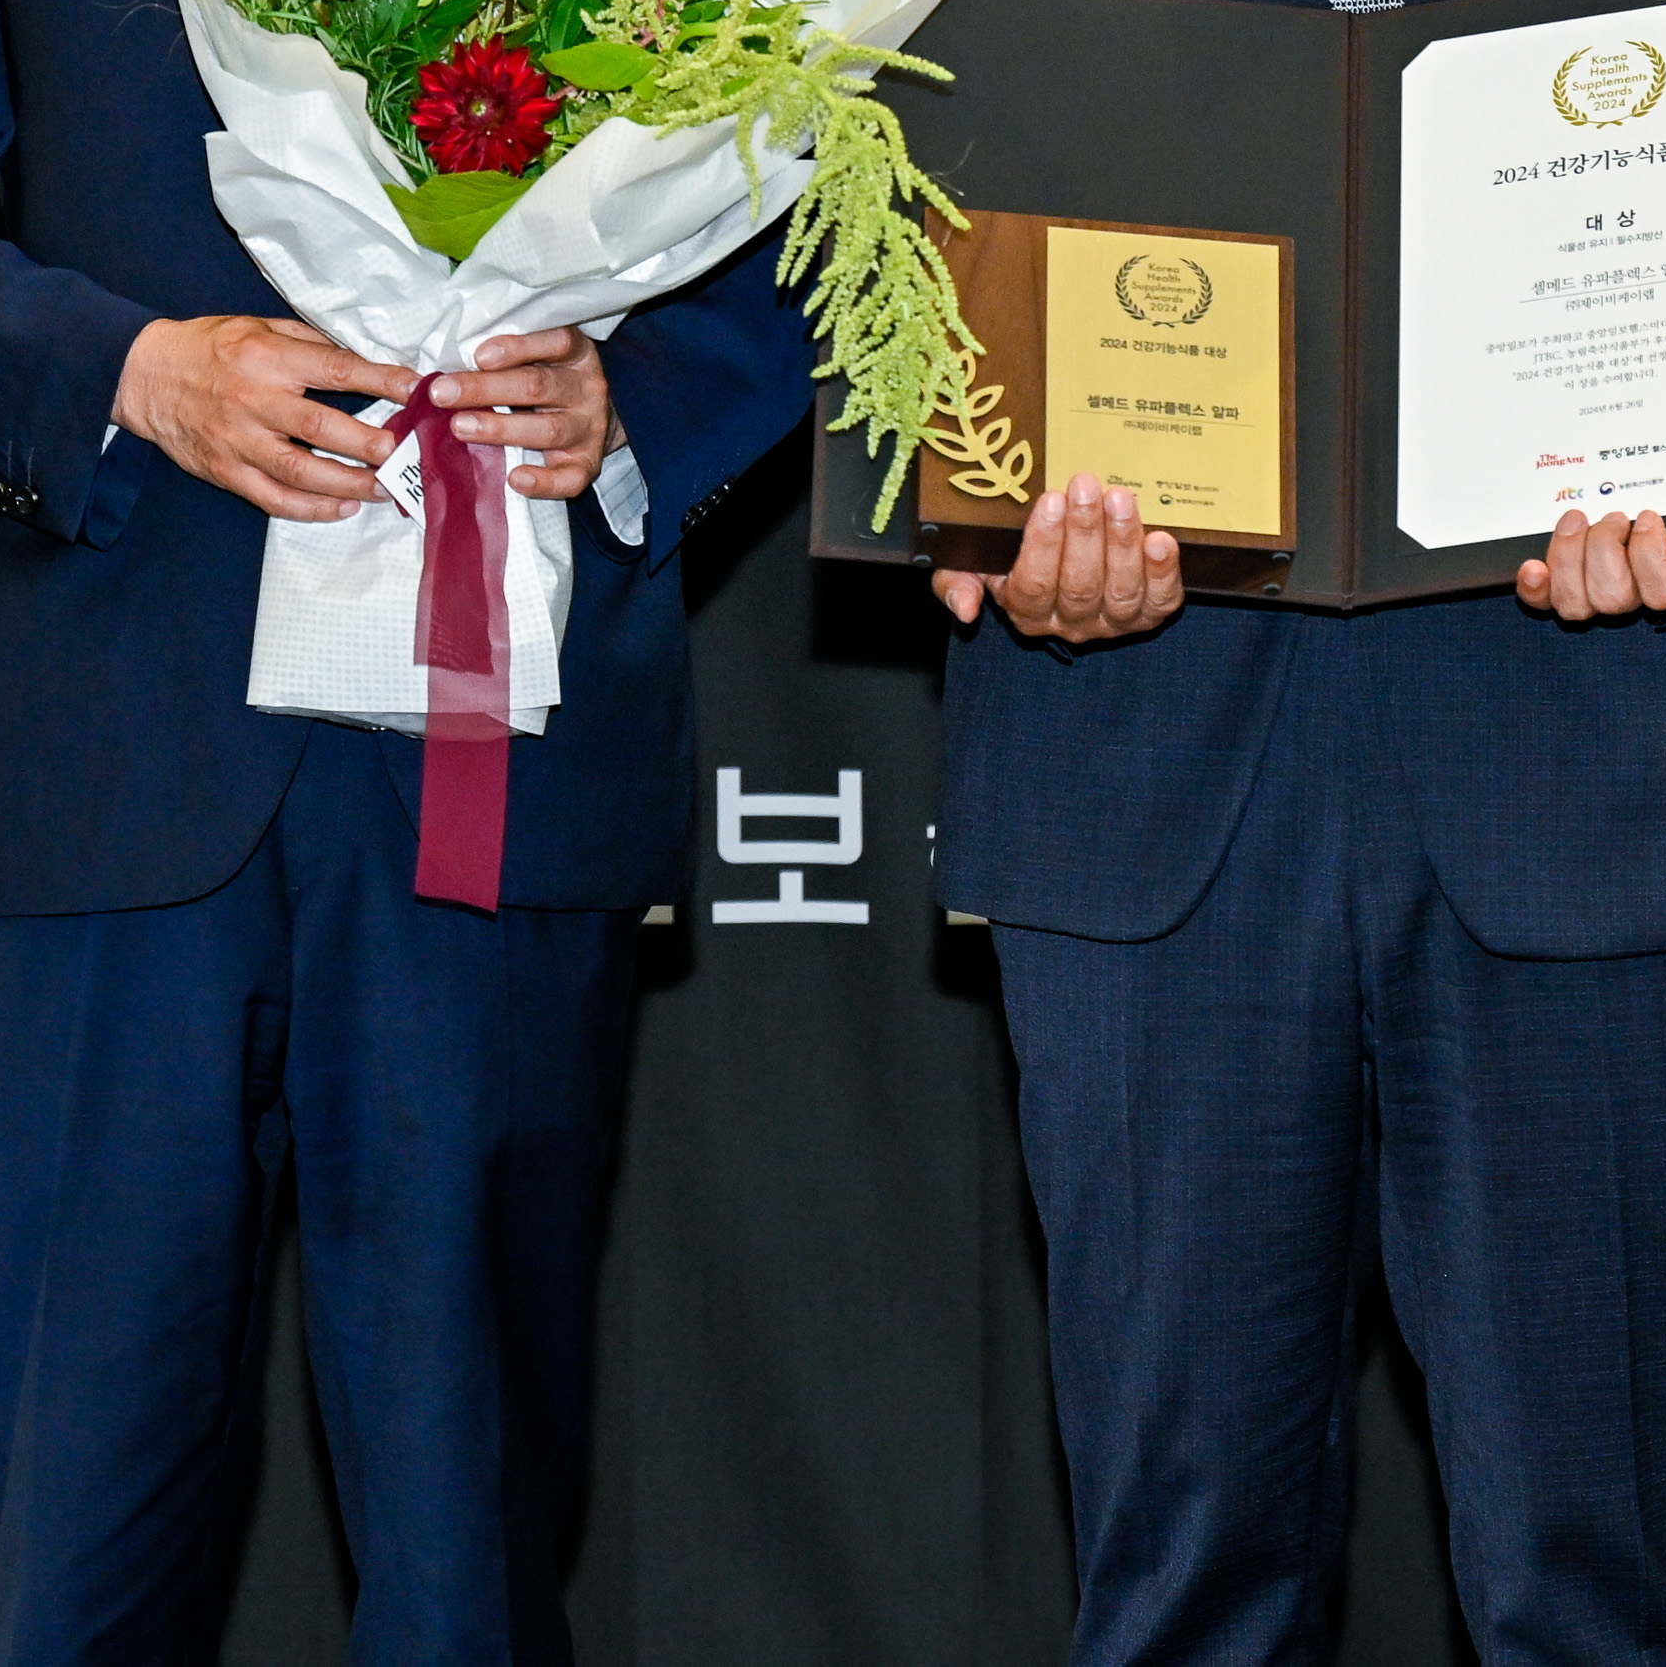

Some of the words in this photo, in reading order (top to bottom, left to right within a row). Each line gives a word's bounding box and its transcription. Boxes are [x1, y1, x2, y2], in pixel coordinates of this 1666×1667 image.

[1591, 53, 1628, 65] Korea
[1590, 63, 1629, 76] Health
[1572, 73, 1648, 91] Supplements
[1587, 86, 1633, 100] Awards
[1594, 98, 1626, 111] 2024
[1493, 161, 1540, 186] 2024
[1557, 240, 1586, 254] 식물성
[1589, 237, 1608, 249] 유지
[1617, 230, 1664, 246] 필수지방산
[1148, 263, 1180, 273] Korea
[1147, 273, 1181, 283] Health
[1532, 276, 1577, 296] 셀메드
[1581, 266, 1657, 288] 유파플렉스
[1132, 280, 1197, 295] Supplements
[1145, 293, 1183, 303] Awards
[1150, 302, 1178, 312] 2024
[1100, 337, 1128, 349] 2024
[1132, 340, 1200, 356] 건강기능식품
[1204, 346, 1227, 359] 대상
[1564, 380, 1574, 390] 이
[1579, 377, 1598, 389] 상을
[1087, 395, 1129, 410] 셀메드
[1135, 399, 1206, 417] 유파플렉스
[1212, 405, 1240, 420] 알파
[1599, 444, 1649, 461] 중앙일보
[1536, 456, 1585, 470] JoongAng
[399, 459, 421, 484] Th
[712, 766, 870, 924] 보
